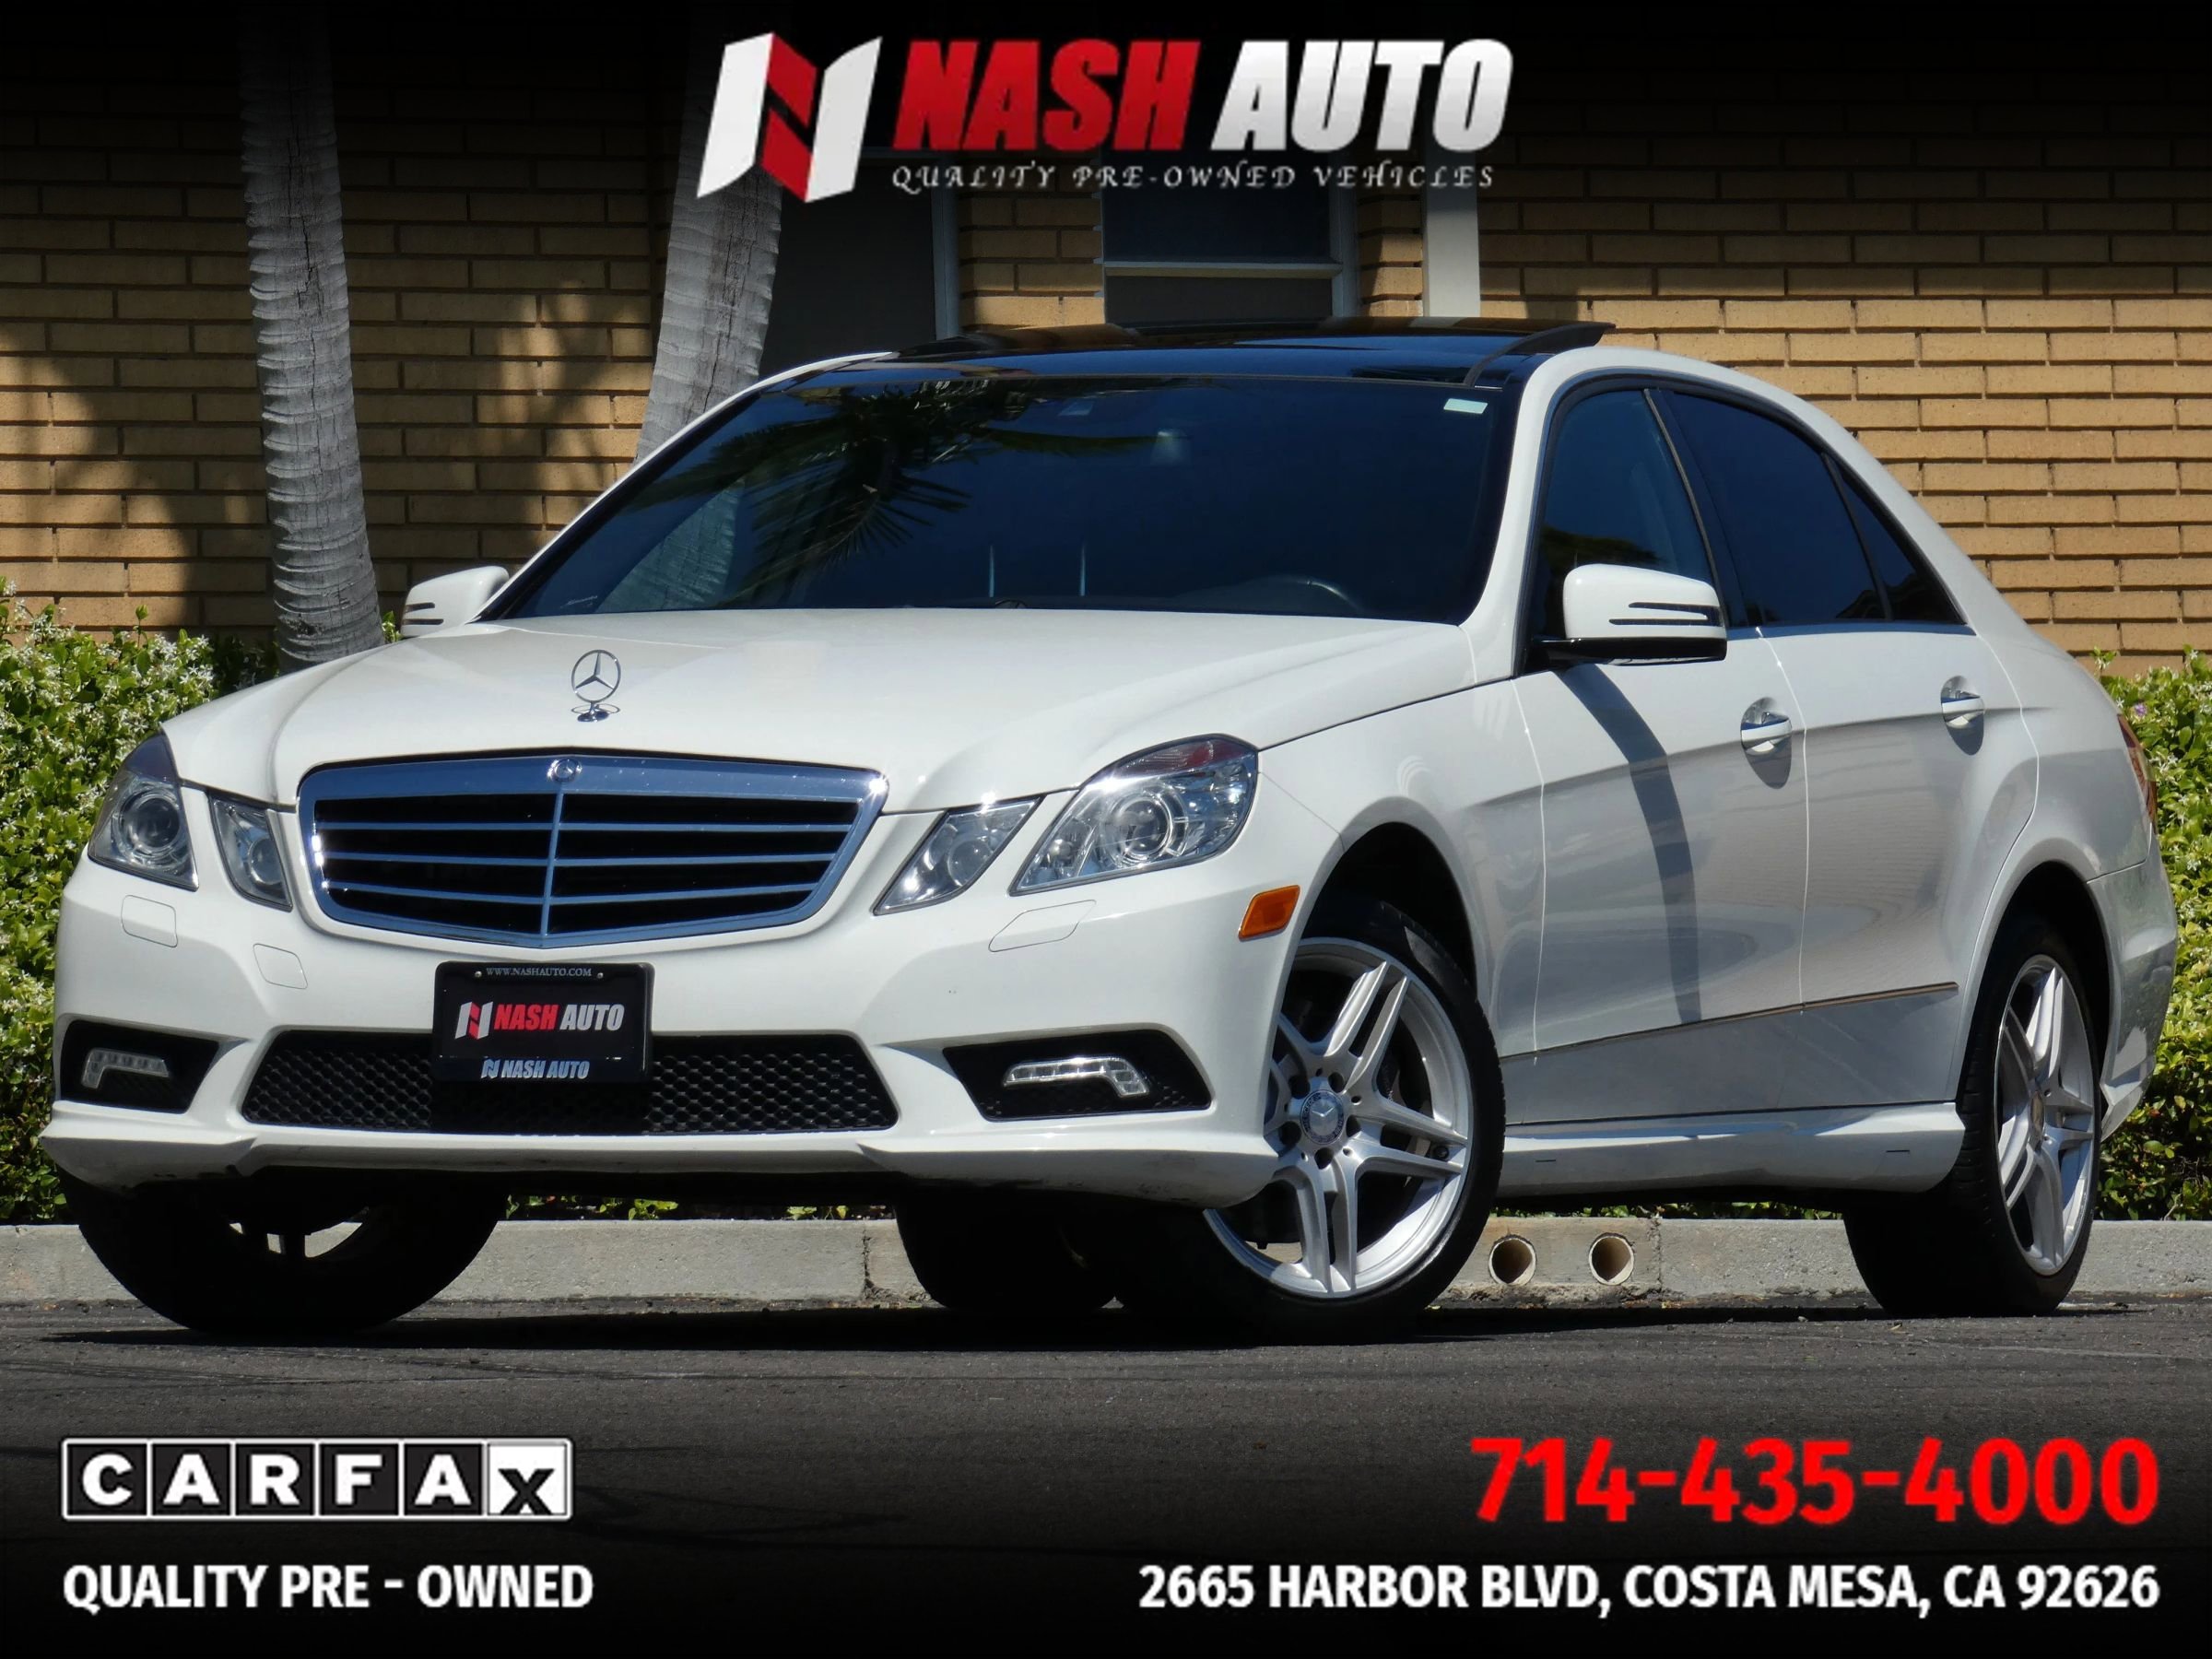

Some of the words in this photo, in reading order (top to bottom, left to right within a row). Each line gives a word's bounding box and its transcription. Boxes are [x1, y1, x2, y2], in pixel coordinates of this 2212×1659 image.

[486, 968, 593, 977] WWW.NASHAUTO.COM
[494, 1004, 560, 1030] NASH
[559, 1004, 625, 1031] AUTO
[500, 1060, 547, 1078] NASH
[546, 1061, 590, 1079] AUTO
